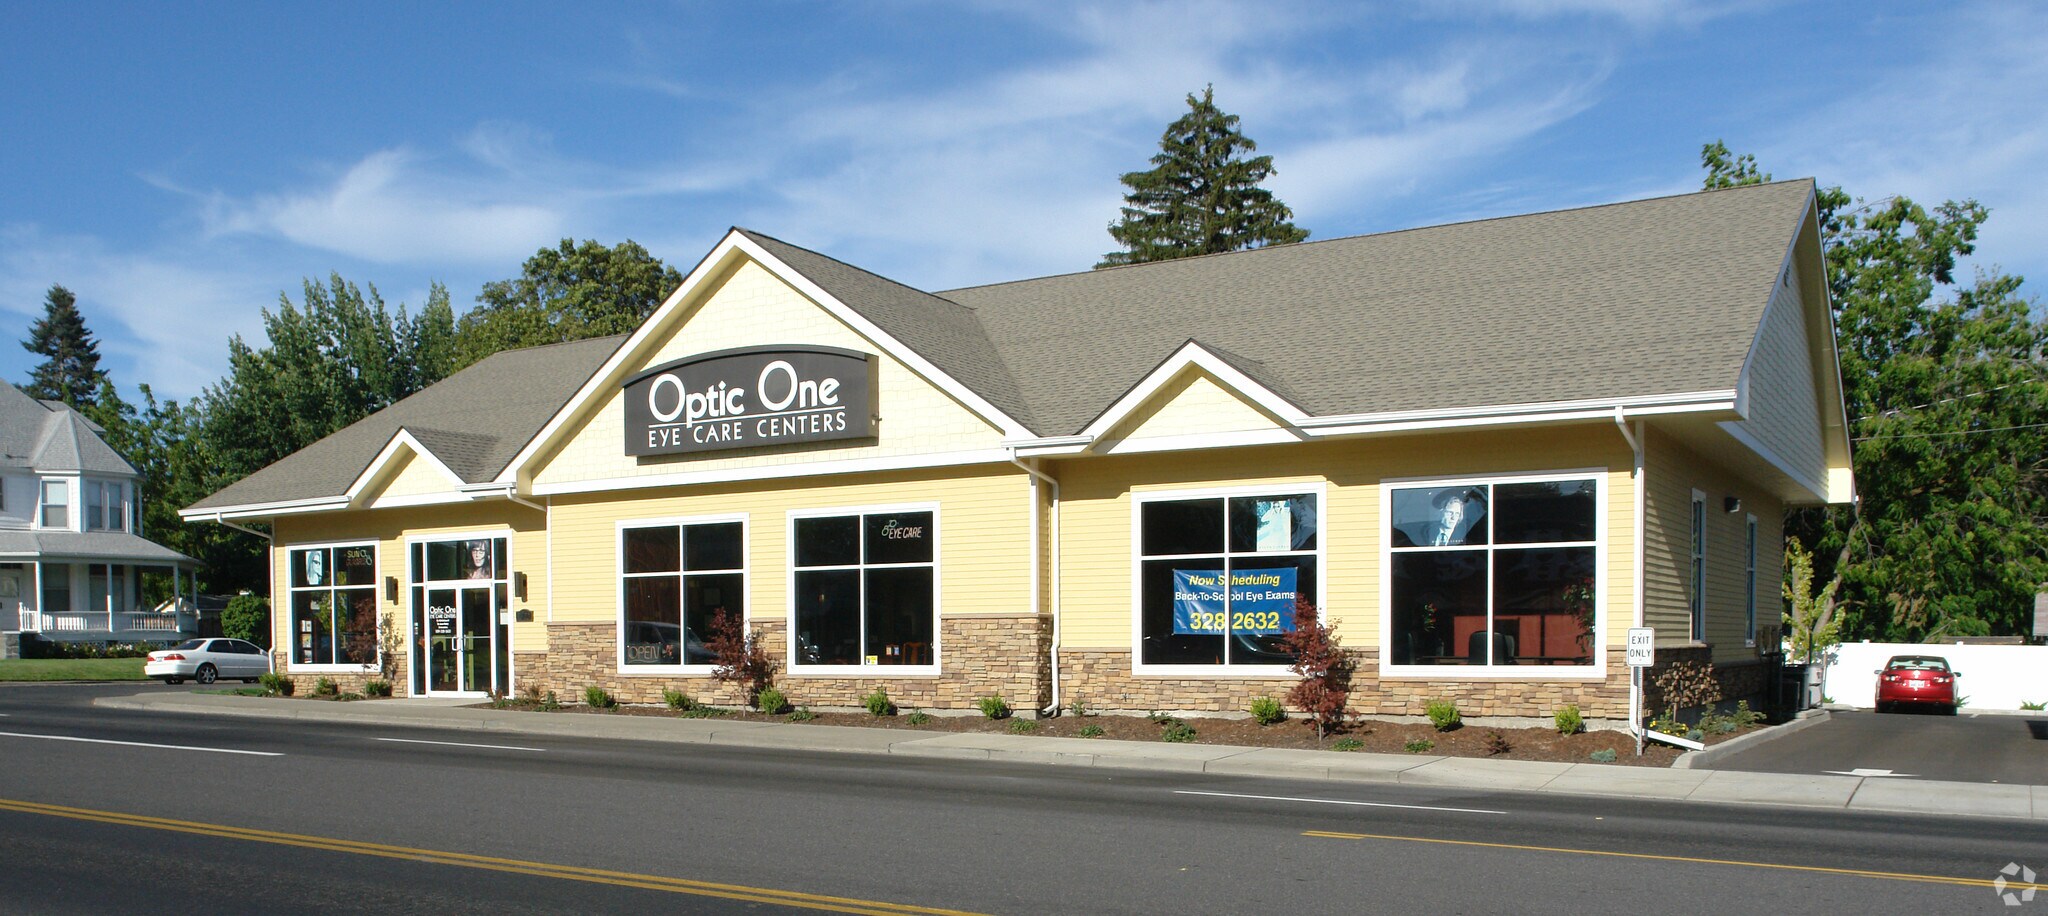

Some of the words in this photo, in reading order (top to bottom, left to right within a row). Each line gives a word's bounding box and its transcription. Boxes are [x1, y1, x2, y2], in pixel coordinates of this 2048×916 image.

[648, 373, 745, 428] Optic
[757, 360, 840, 411] One
[648, 427, 681, 448] EYE
[693, 421, 743, 444] CARE
[756, 411, 846, 438] CENTERS
[888, 527, 903, 539] EYE
[903, 526, 922, 539] CARE
[1189, 575, 1215, 586] Now
[1218, 574, 1280, 587] Sheduling
[1175, 591, 1244, 601] Back-To-Scool
[1246, 592, 1263, 602] Eye
[1265, 591, 1295, 600] Exams
[1631, 636, 1650, 645] EXIT
[628, 645, 660, 660] OPEN
[1630, 649, 1651, 658] ONLY
